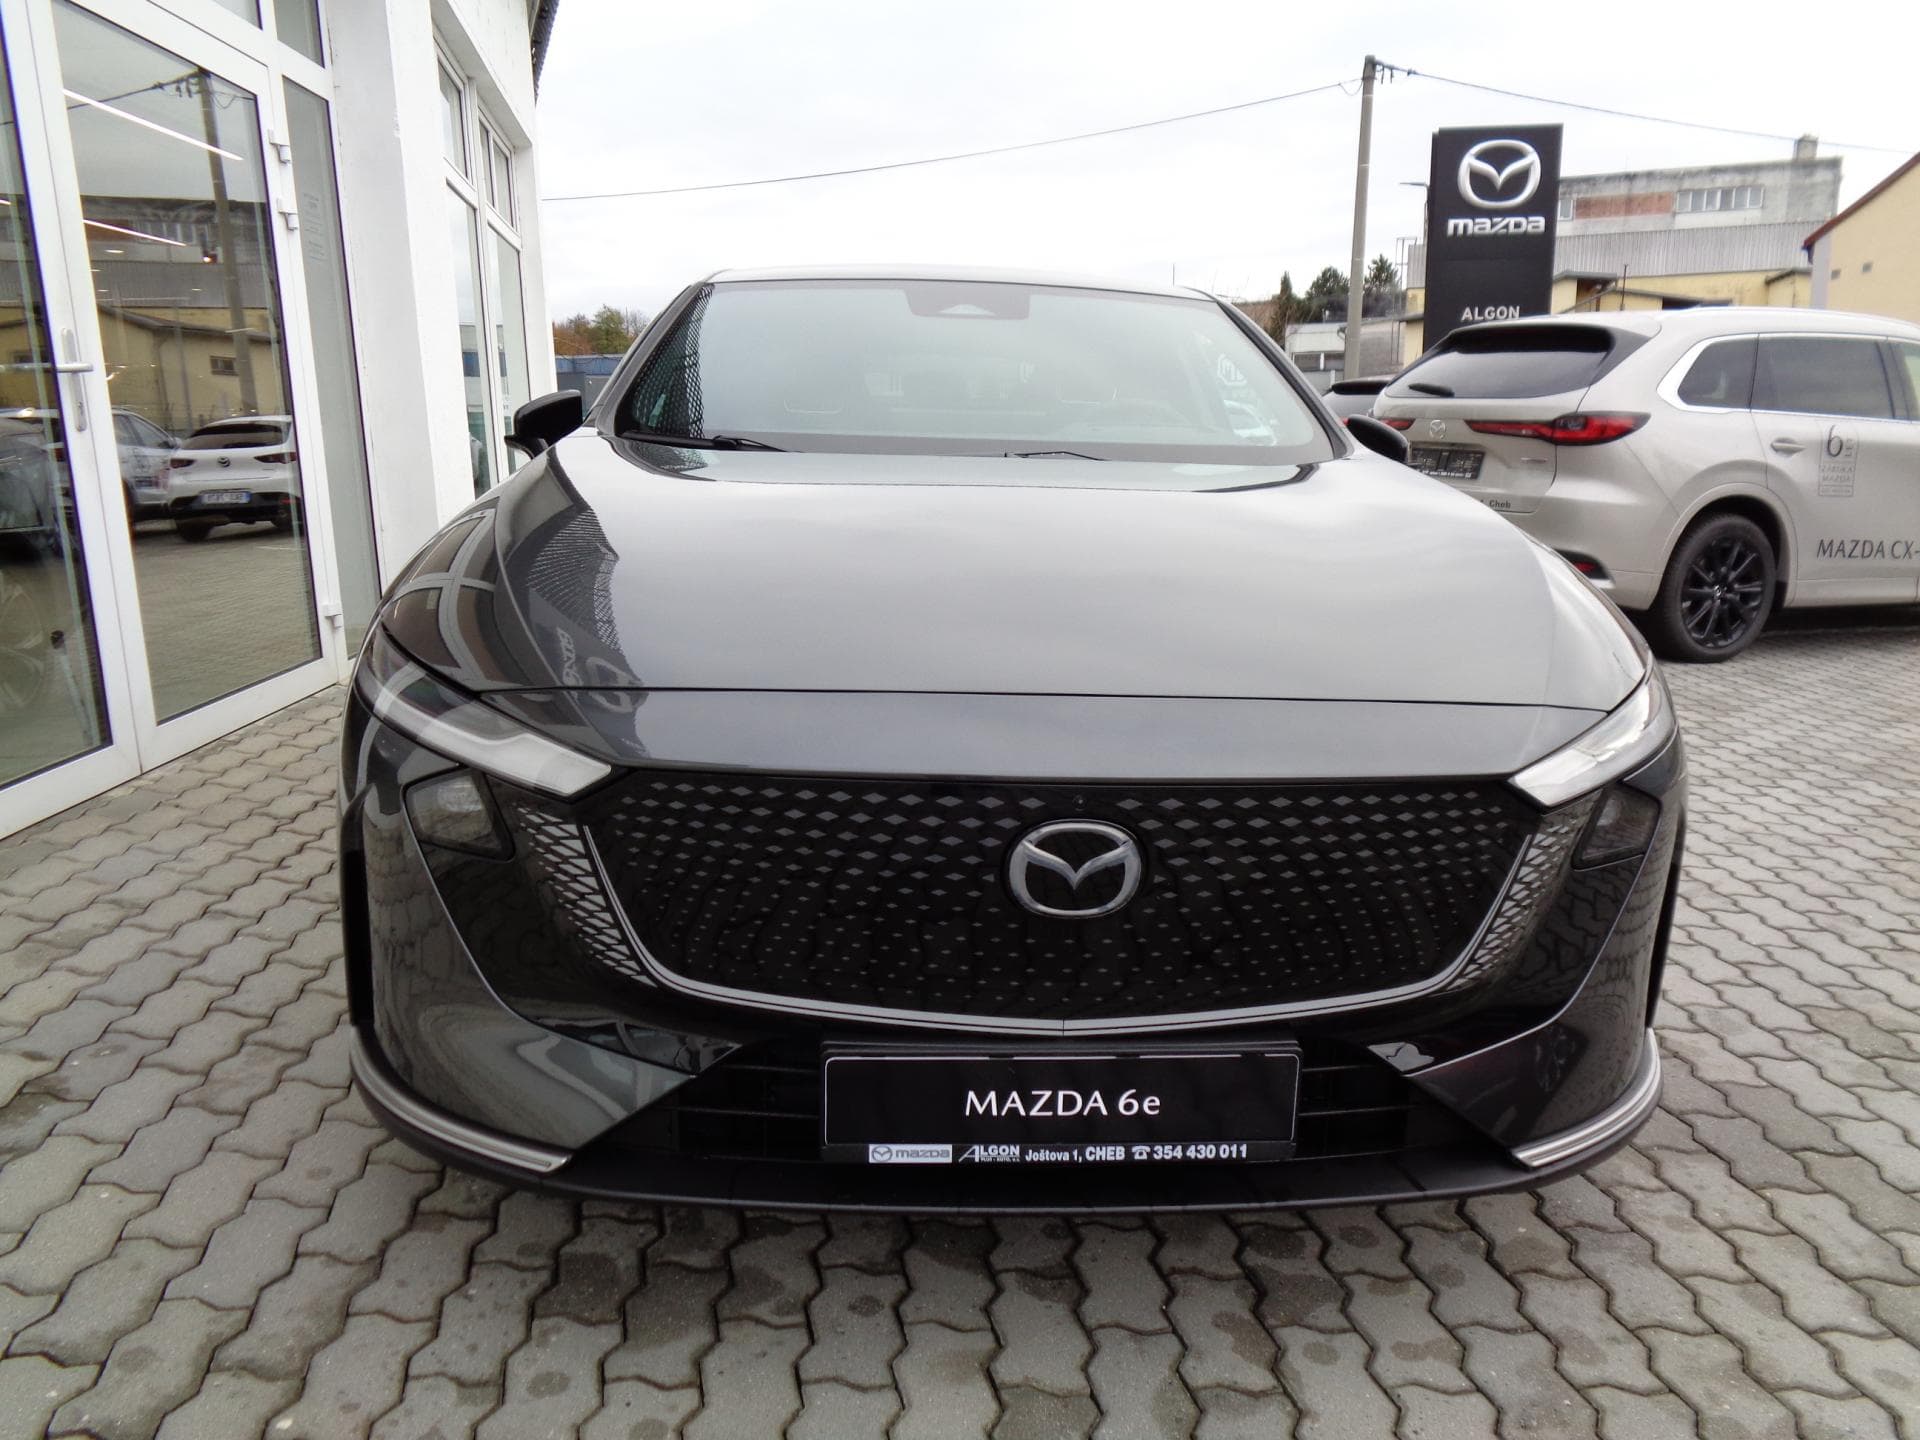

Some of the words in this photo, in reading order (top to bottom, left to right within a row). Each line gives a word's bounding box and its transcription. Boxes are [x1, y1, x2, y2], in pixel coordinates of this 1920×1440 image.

[1461, 305, 1520, 322] ALGON
[1827, 424, 1844, 457] 6
[1489, 500, 1511, 509] Cheb
[1816, 539, 1886, 559] MAZDA
[965, 1090, 1109, 1116] MAZDA
[1117, 1089, 1161, 1115] 6e
[959, 1145, 1020, 1162] ALGON
[1025, 1149, 1070, 1162] Joštova
[1072, 1149, 1083, 1163] 1,
[1085, 1146, 1126, 1160] CHEB
[1153, 1145, 1183, 1159] 354
[1186, 1145, 1217, 1159] 430
[1219, 1143, 1248, 1159] 011
